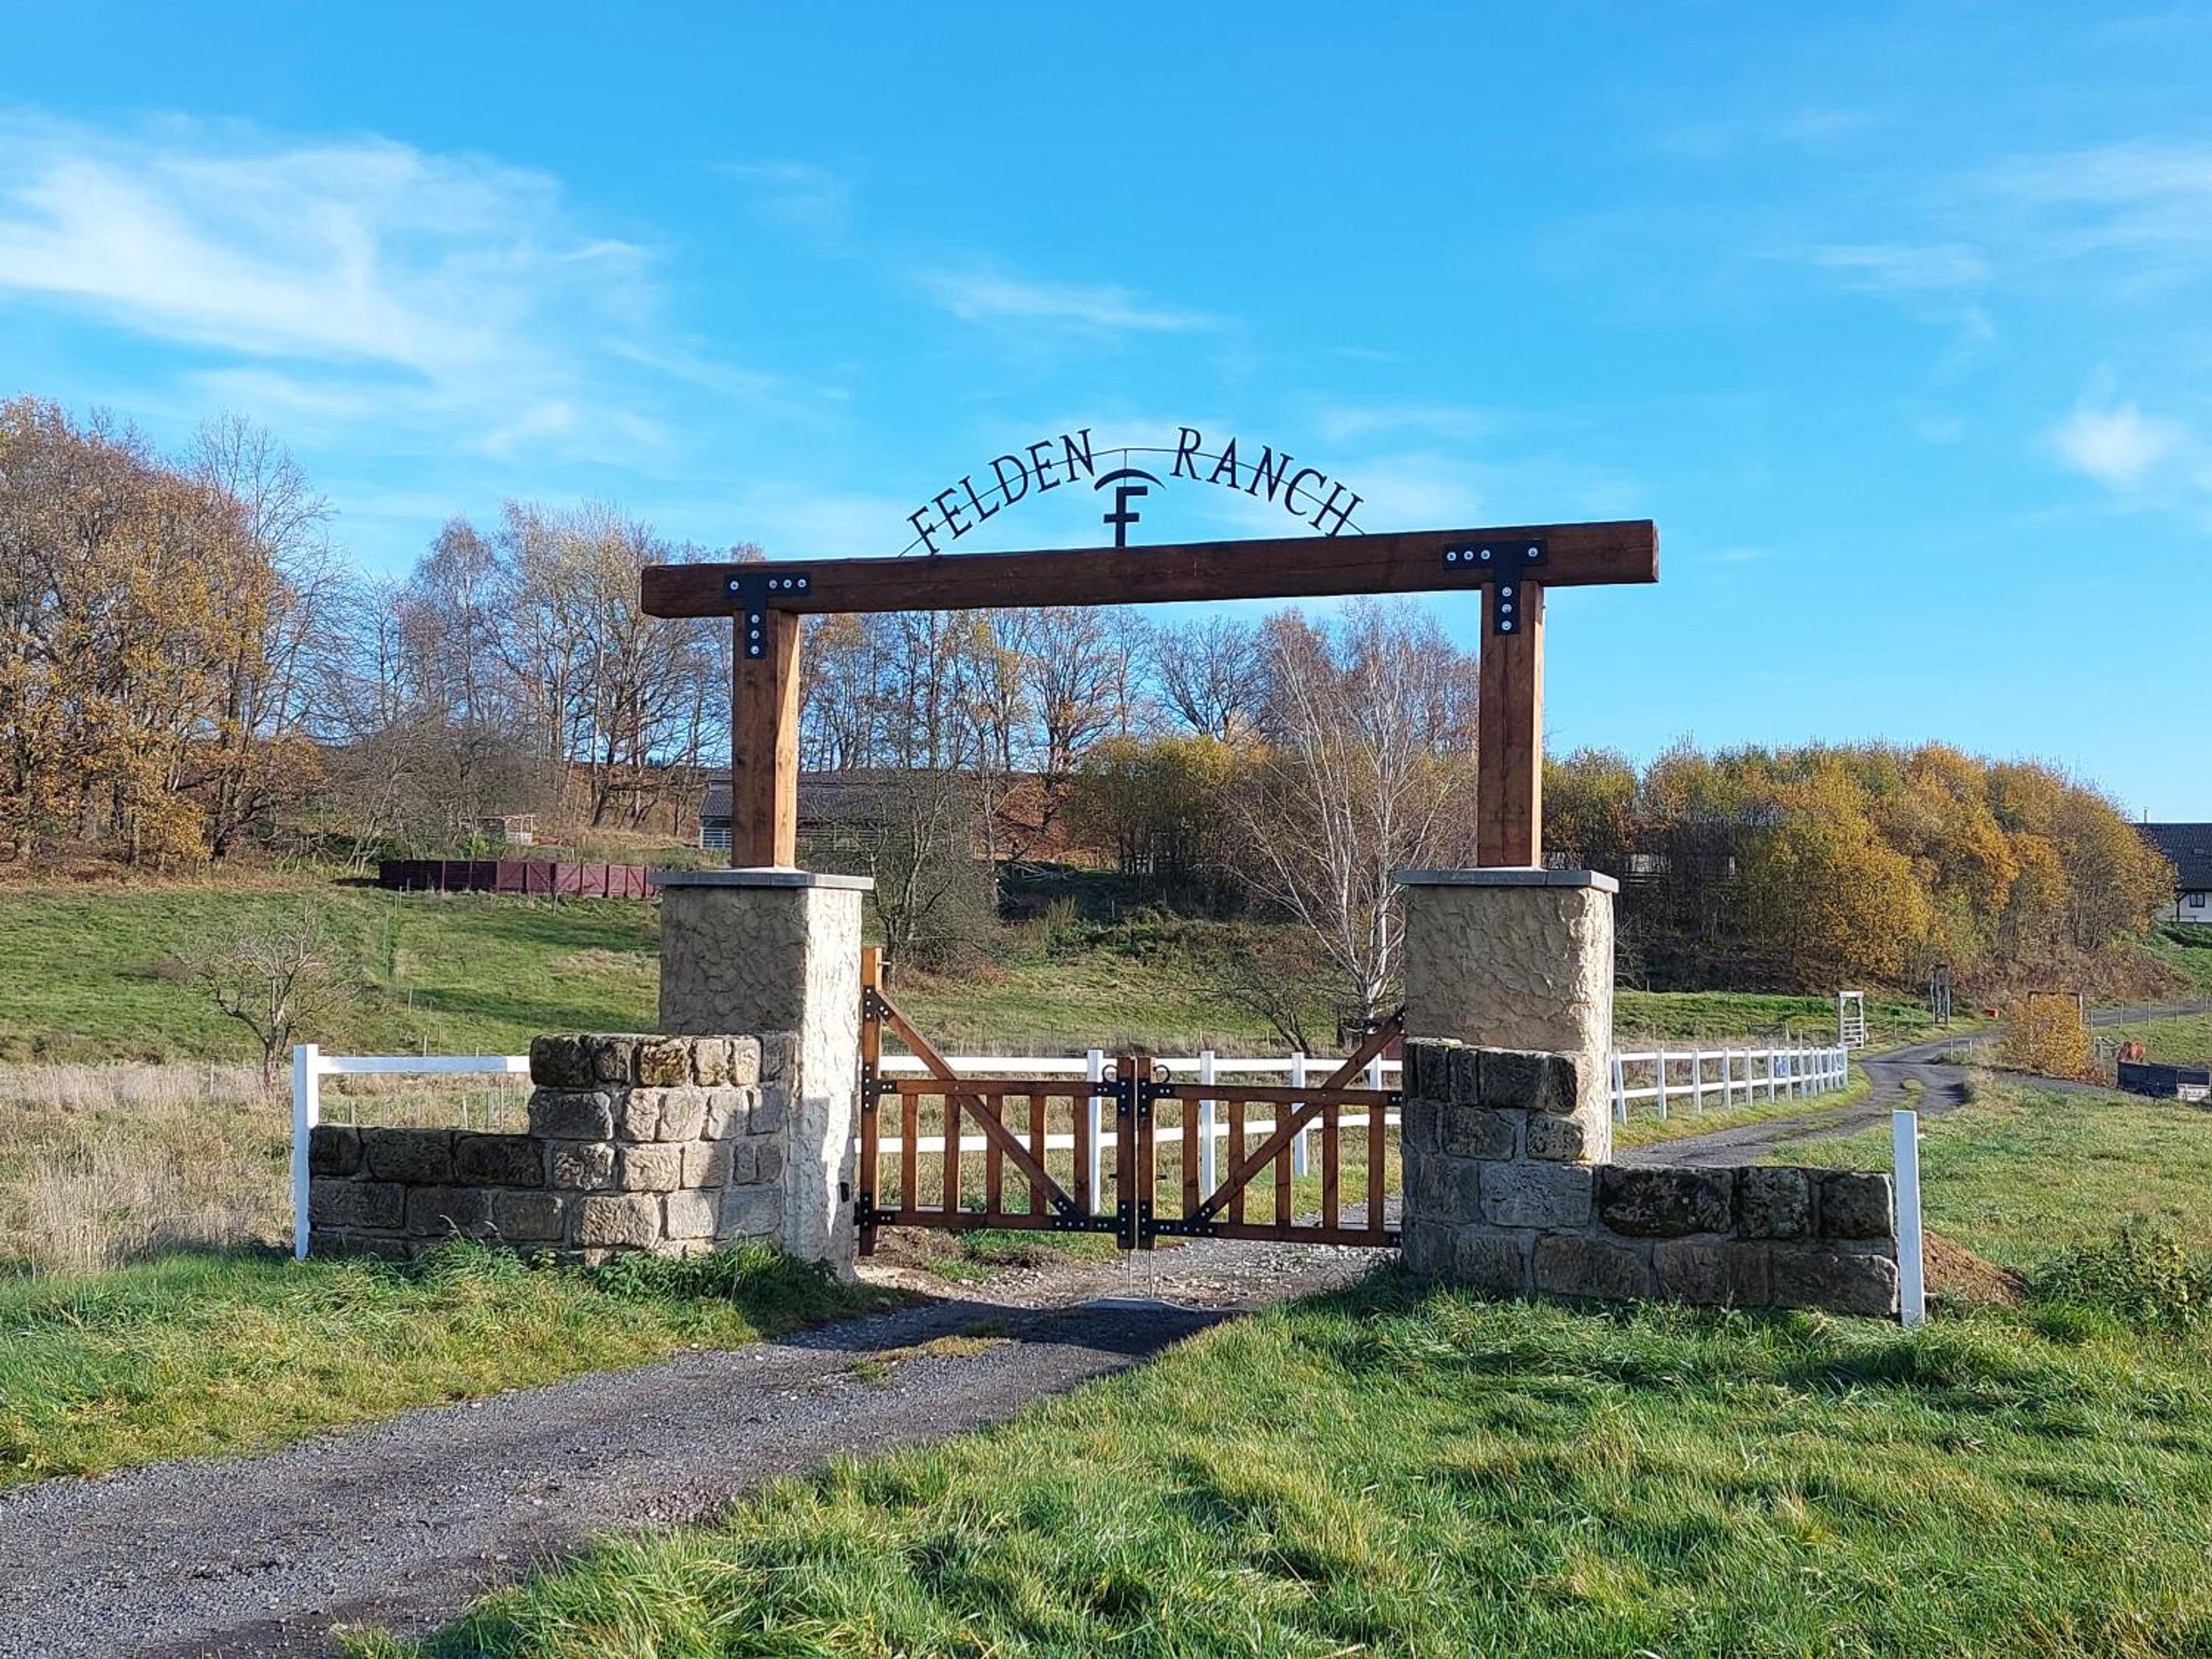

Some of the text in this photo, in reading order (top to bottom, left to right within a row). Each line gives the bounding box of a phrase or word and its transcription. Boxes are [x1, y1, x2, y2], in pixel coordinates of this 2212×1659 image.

[906, 427, 1364, 554] FELDEN RANCH
[1103, 486, 1148, 548] F
